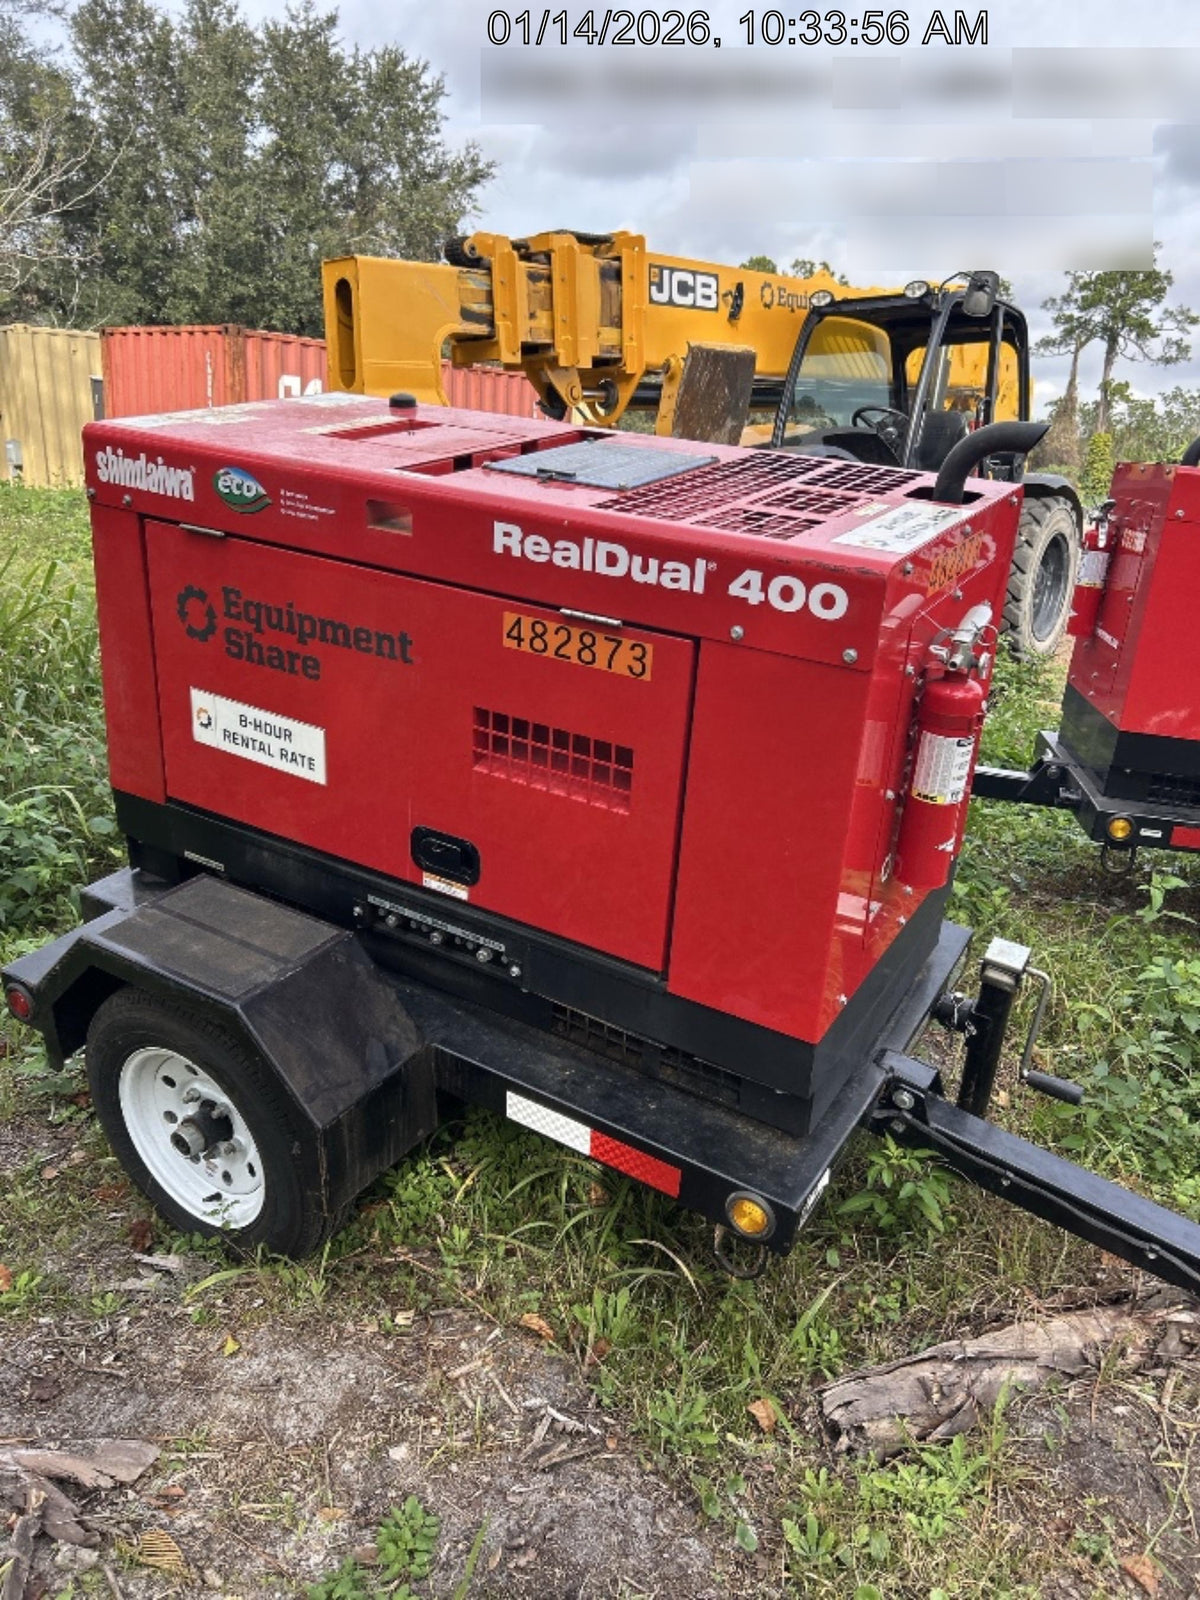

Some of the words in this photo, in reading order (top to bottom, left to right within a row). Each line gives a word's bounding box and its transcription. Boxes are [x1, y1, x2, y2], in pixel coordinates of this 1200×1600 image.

[650, 268, 718, 309] JCB
[777, 286, 810, 313] Equi
[96, 446, 194, 501] shindaiwa
[728, 569, 848, 621] 400
[222, 586, 413, 664] Equipment
[505, 616, 649, 678] 482873
[224, 627, 321, 681] Share
[223, 728, 274, 757] RENTAL
[280, 748, 316, 771] RATE
